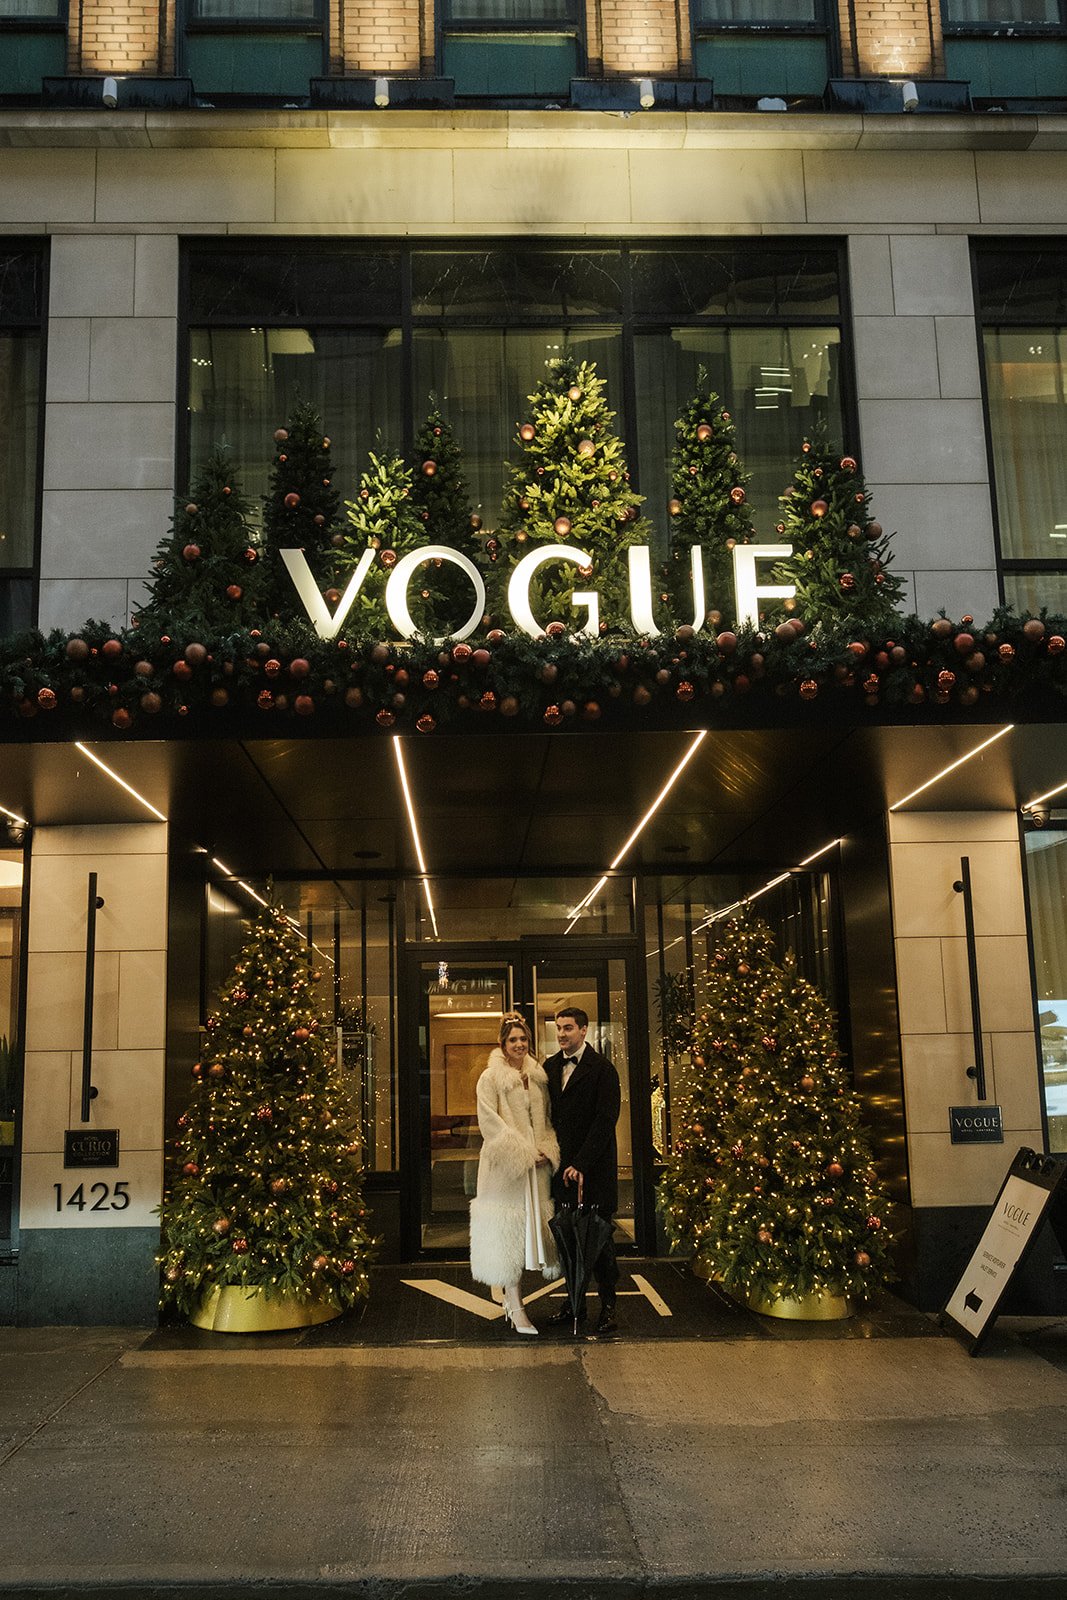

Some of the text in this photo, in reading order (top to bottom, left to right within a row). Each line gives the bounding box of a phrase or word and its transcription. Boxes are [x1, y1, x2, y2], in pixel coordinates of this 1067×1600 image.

[278, 544, 797, 642] VOGUE
[955, 1117, 999, 1128] VOGUE
[72, 1141, 111, 1151] CURIO
[53, 1182, 131, 1212] 1425
[1002, 1202, 1031, 1227] VOGUE
